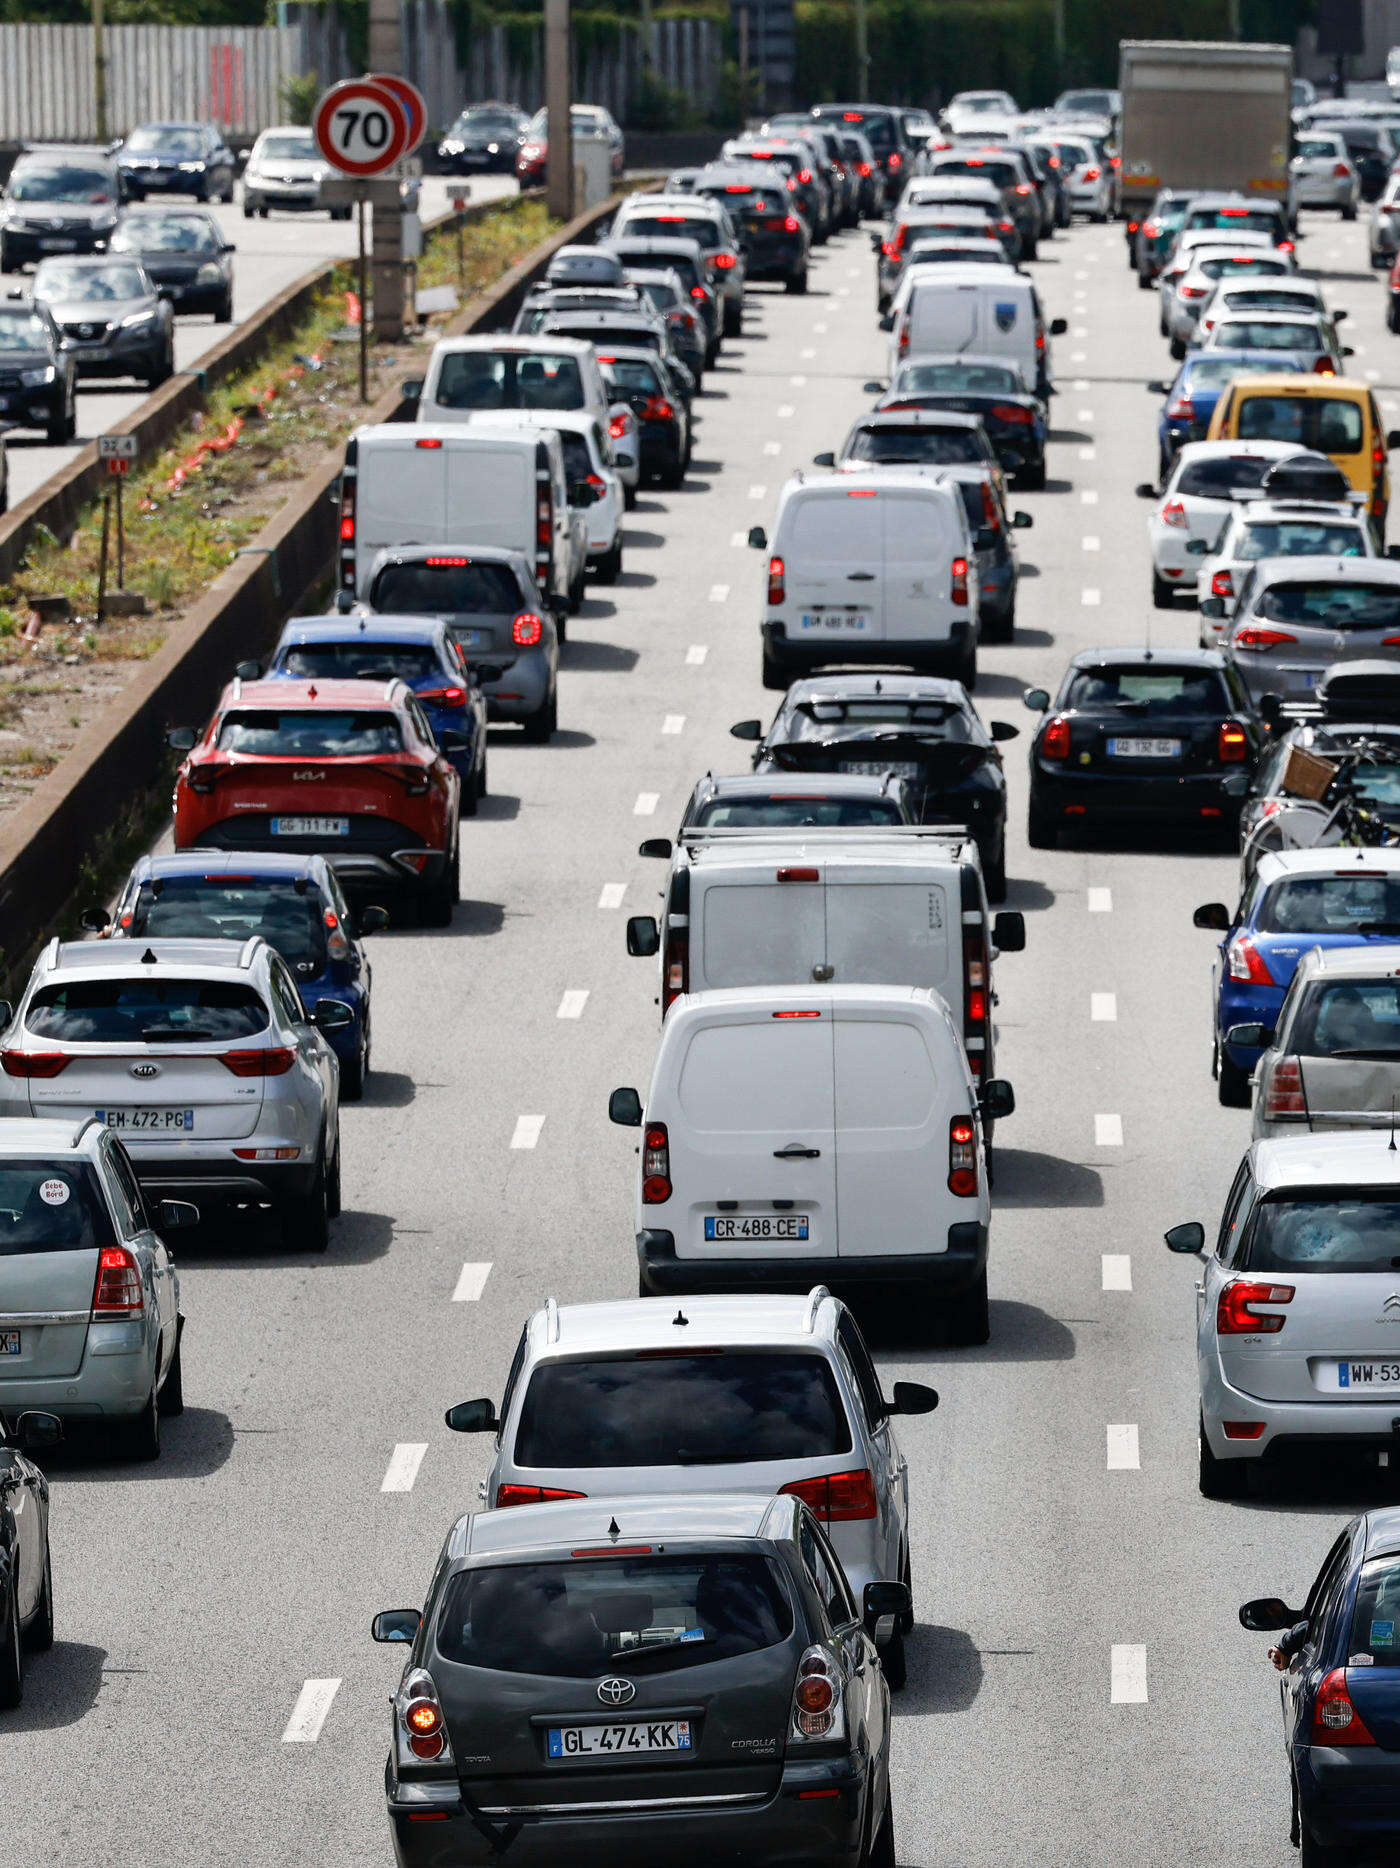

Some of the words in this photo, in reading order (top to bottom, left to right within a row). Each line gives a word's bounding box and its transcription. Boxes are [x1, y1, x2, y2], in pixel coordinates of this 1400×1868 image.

[338, 112, 388, 149] 70
[107, 1112, 183, 1127] EM-472-PG
[716, 1219, 796, 1237] CR-488-CE
[564, 1725, 676, 1753] GL-474-KK
[679, 1734, 690, 1747] 75
